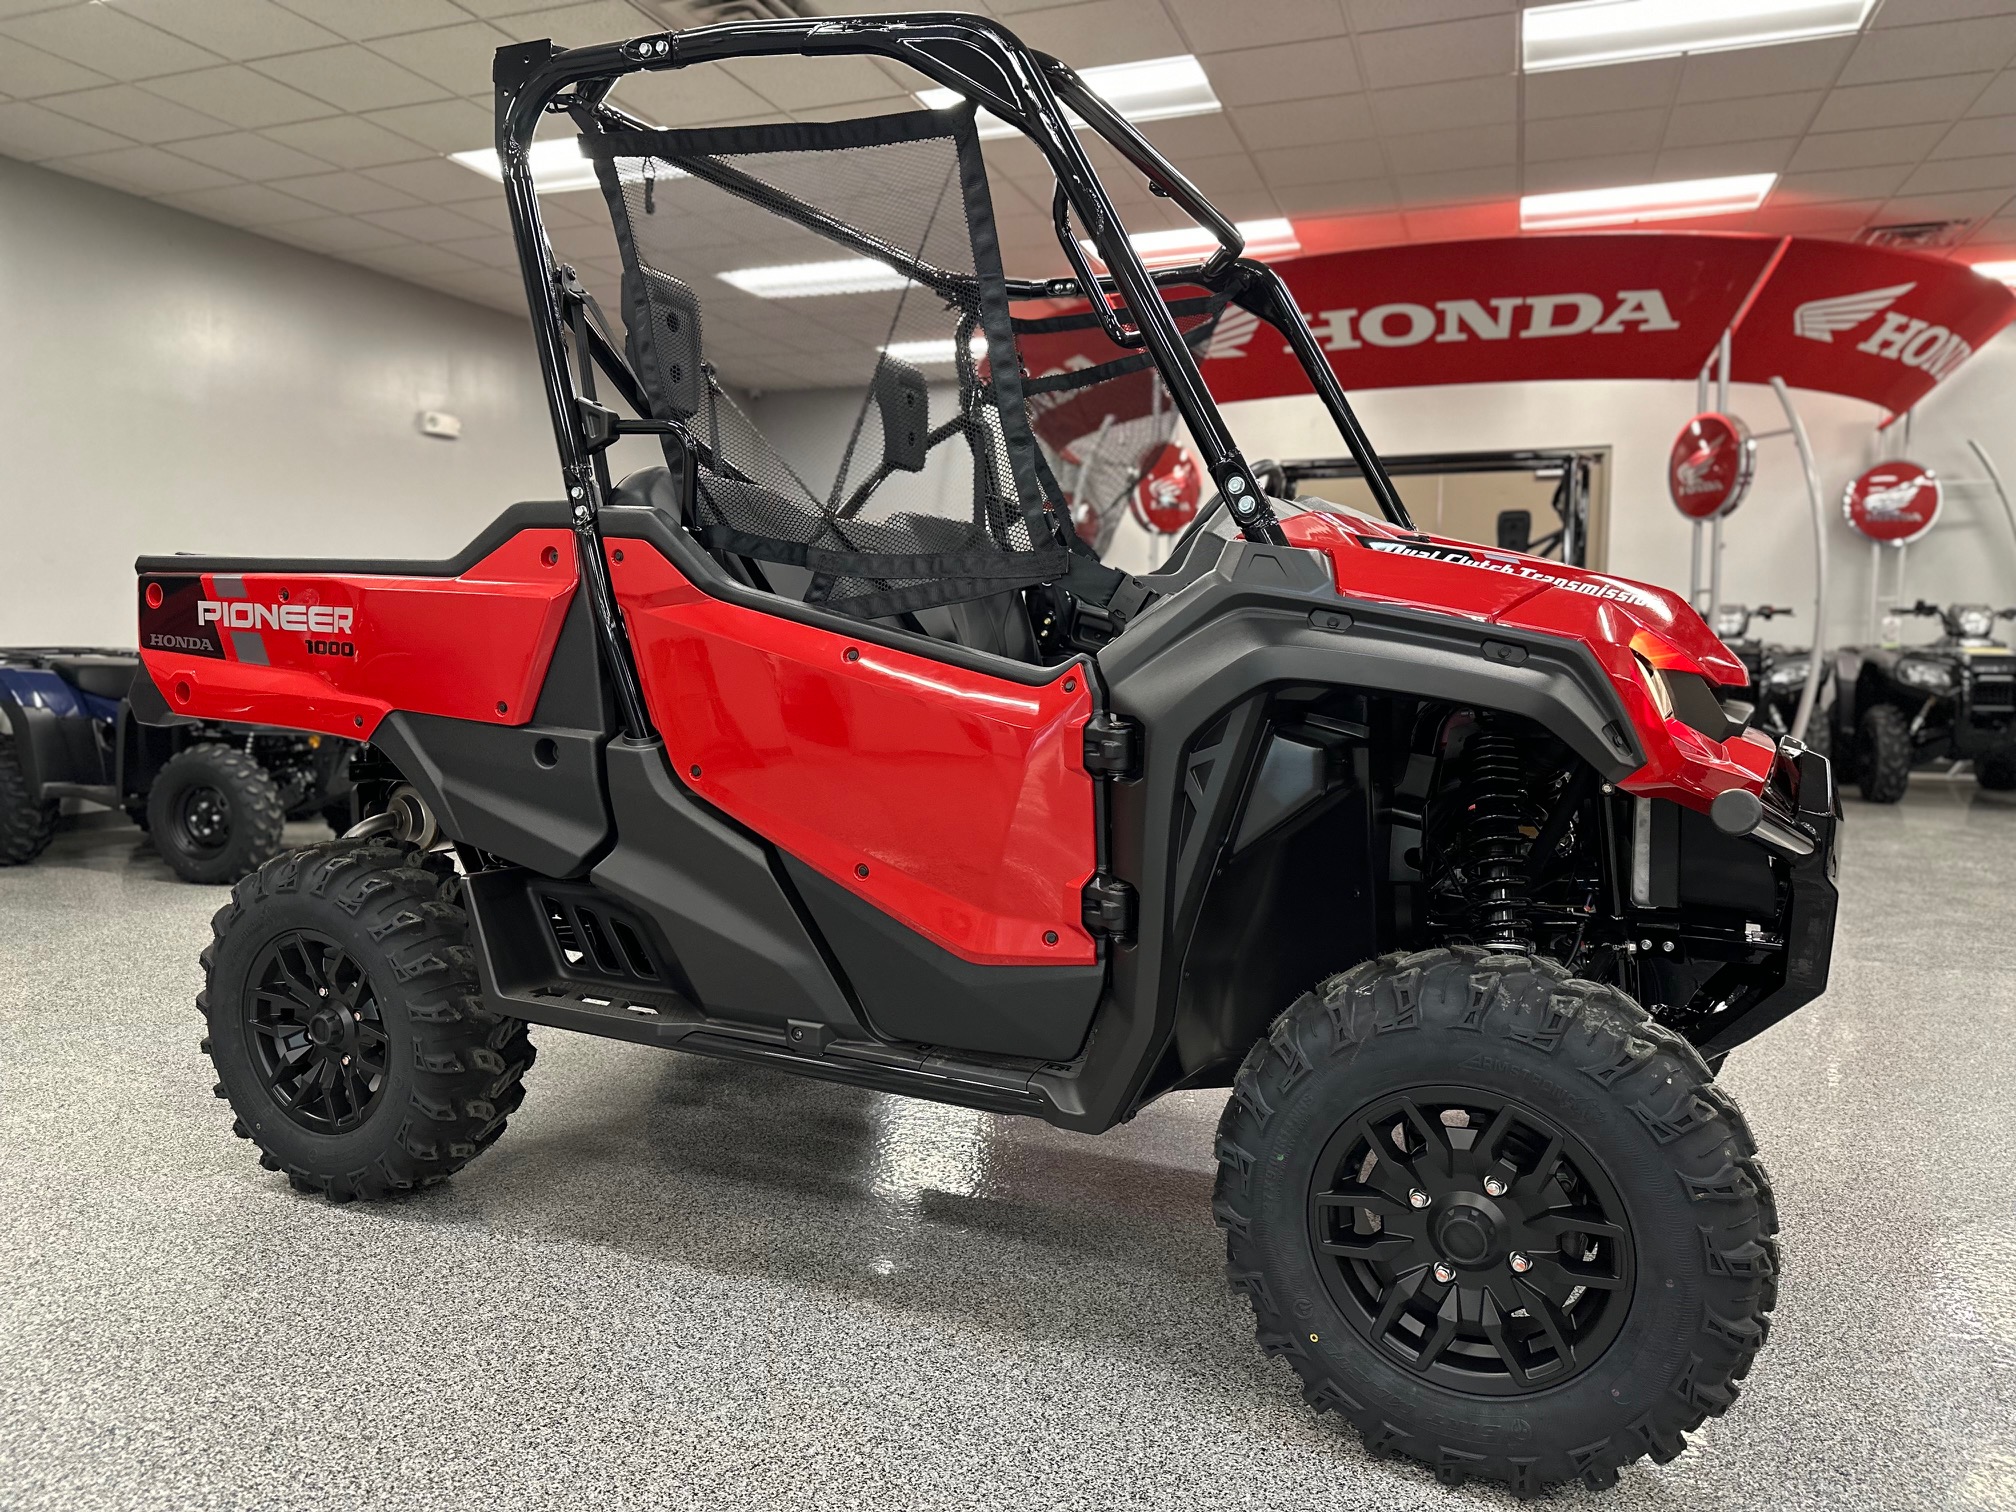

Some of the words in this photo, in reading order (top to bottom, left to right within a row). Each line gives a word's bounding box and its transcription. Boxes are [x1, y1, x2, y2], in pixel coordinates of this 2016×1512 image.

[1283, 289, 1680, 354] HONDA
[1519, 567, 1658, 609] Transmissio
[197, 600, 354, 635] PIONEER
[150, 633, 214, 651] HONDA
[304, 639, 354, 657] 1000
